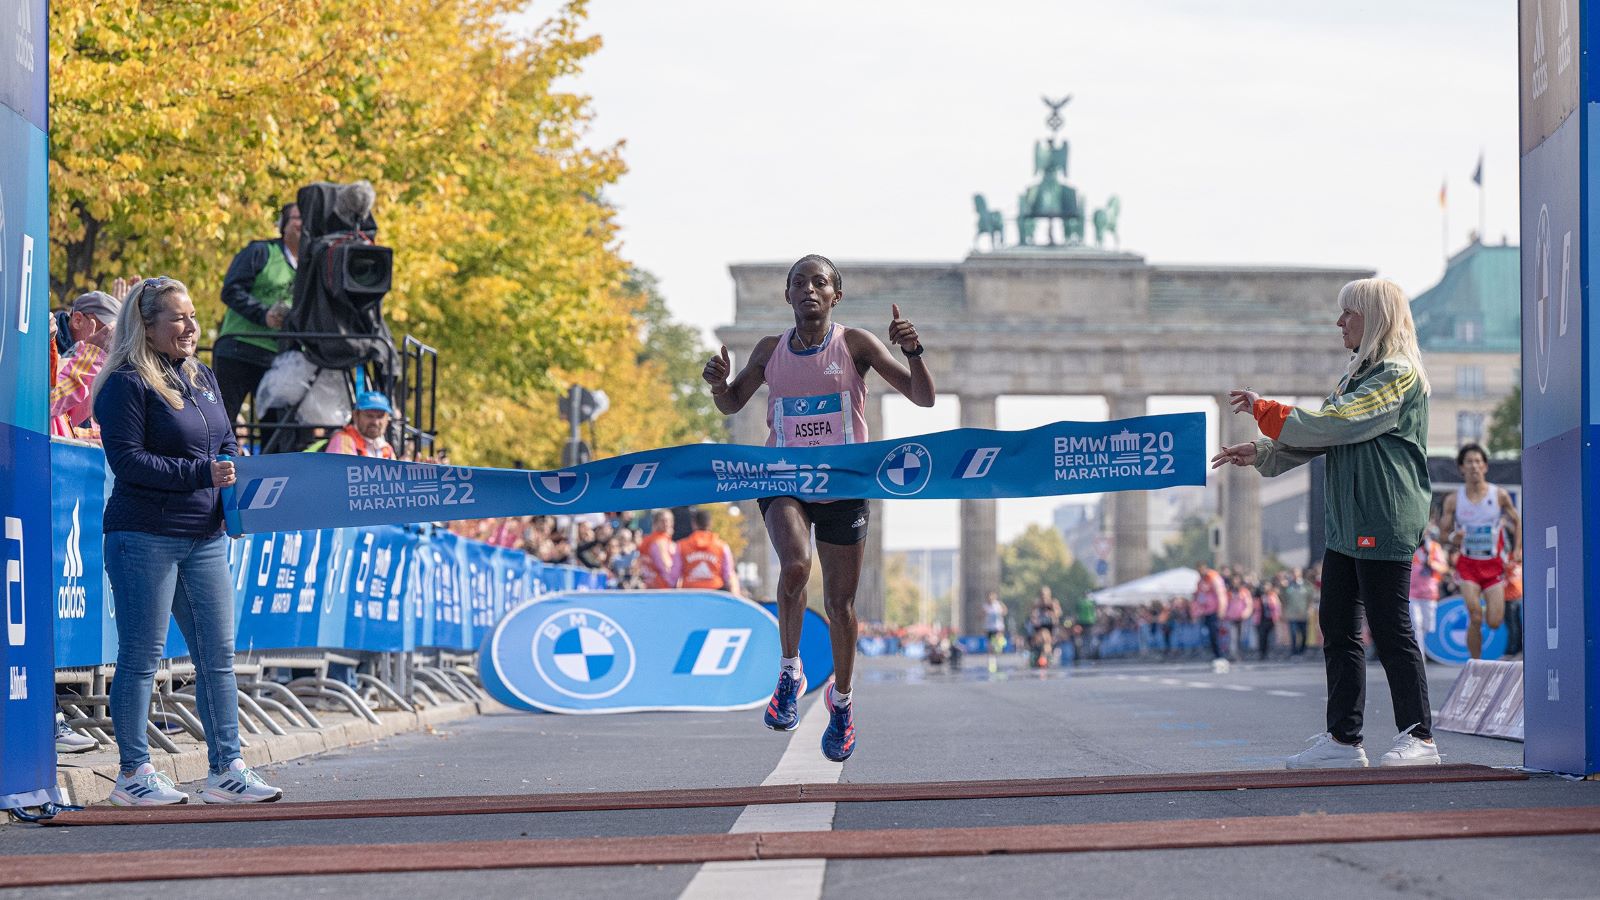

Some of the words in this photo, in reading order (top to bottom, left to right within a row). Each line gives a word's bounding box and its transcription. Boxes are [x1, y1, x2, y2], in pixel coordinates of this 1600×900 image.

[796, 421, 832, 438] ASSEFA
[1054, 436, 1108, 454] BMW
[1142, 432, 1174, 453] 20
[712, 460, 765, 474] BMW
[1054, 454, 1108, 467] BERLIN
[1144, 454, 1175, 476] 22
[346, 464, 402, 483] BMW
[1055, 465, 1142, 480] MARATHON
[348, 482, 406, 497] BERLIN
[716, 480, 797, 492] MARATHON
[800, 472, 829, 493] 22
[349, 494, 440, 511] MARATHON
[442, 483, 475, 505] 22
[58, 576, 86, 619] adidas
